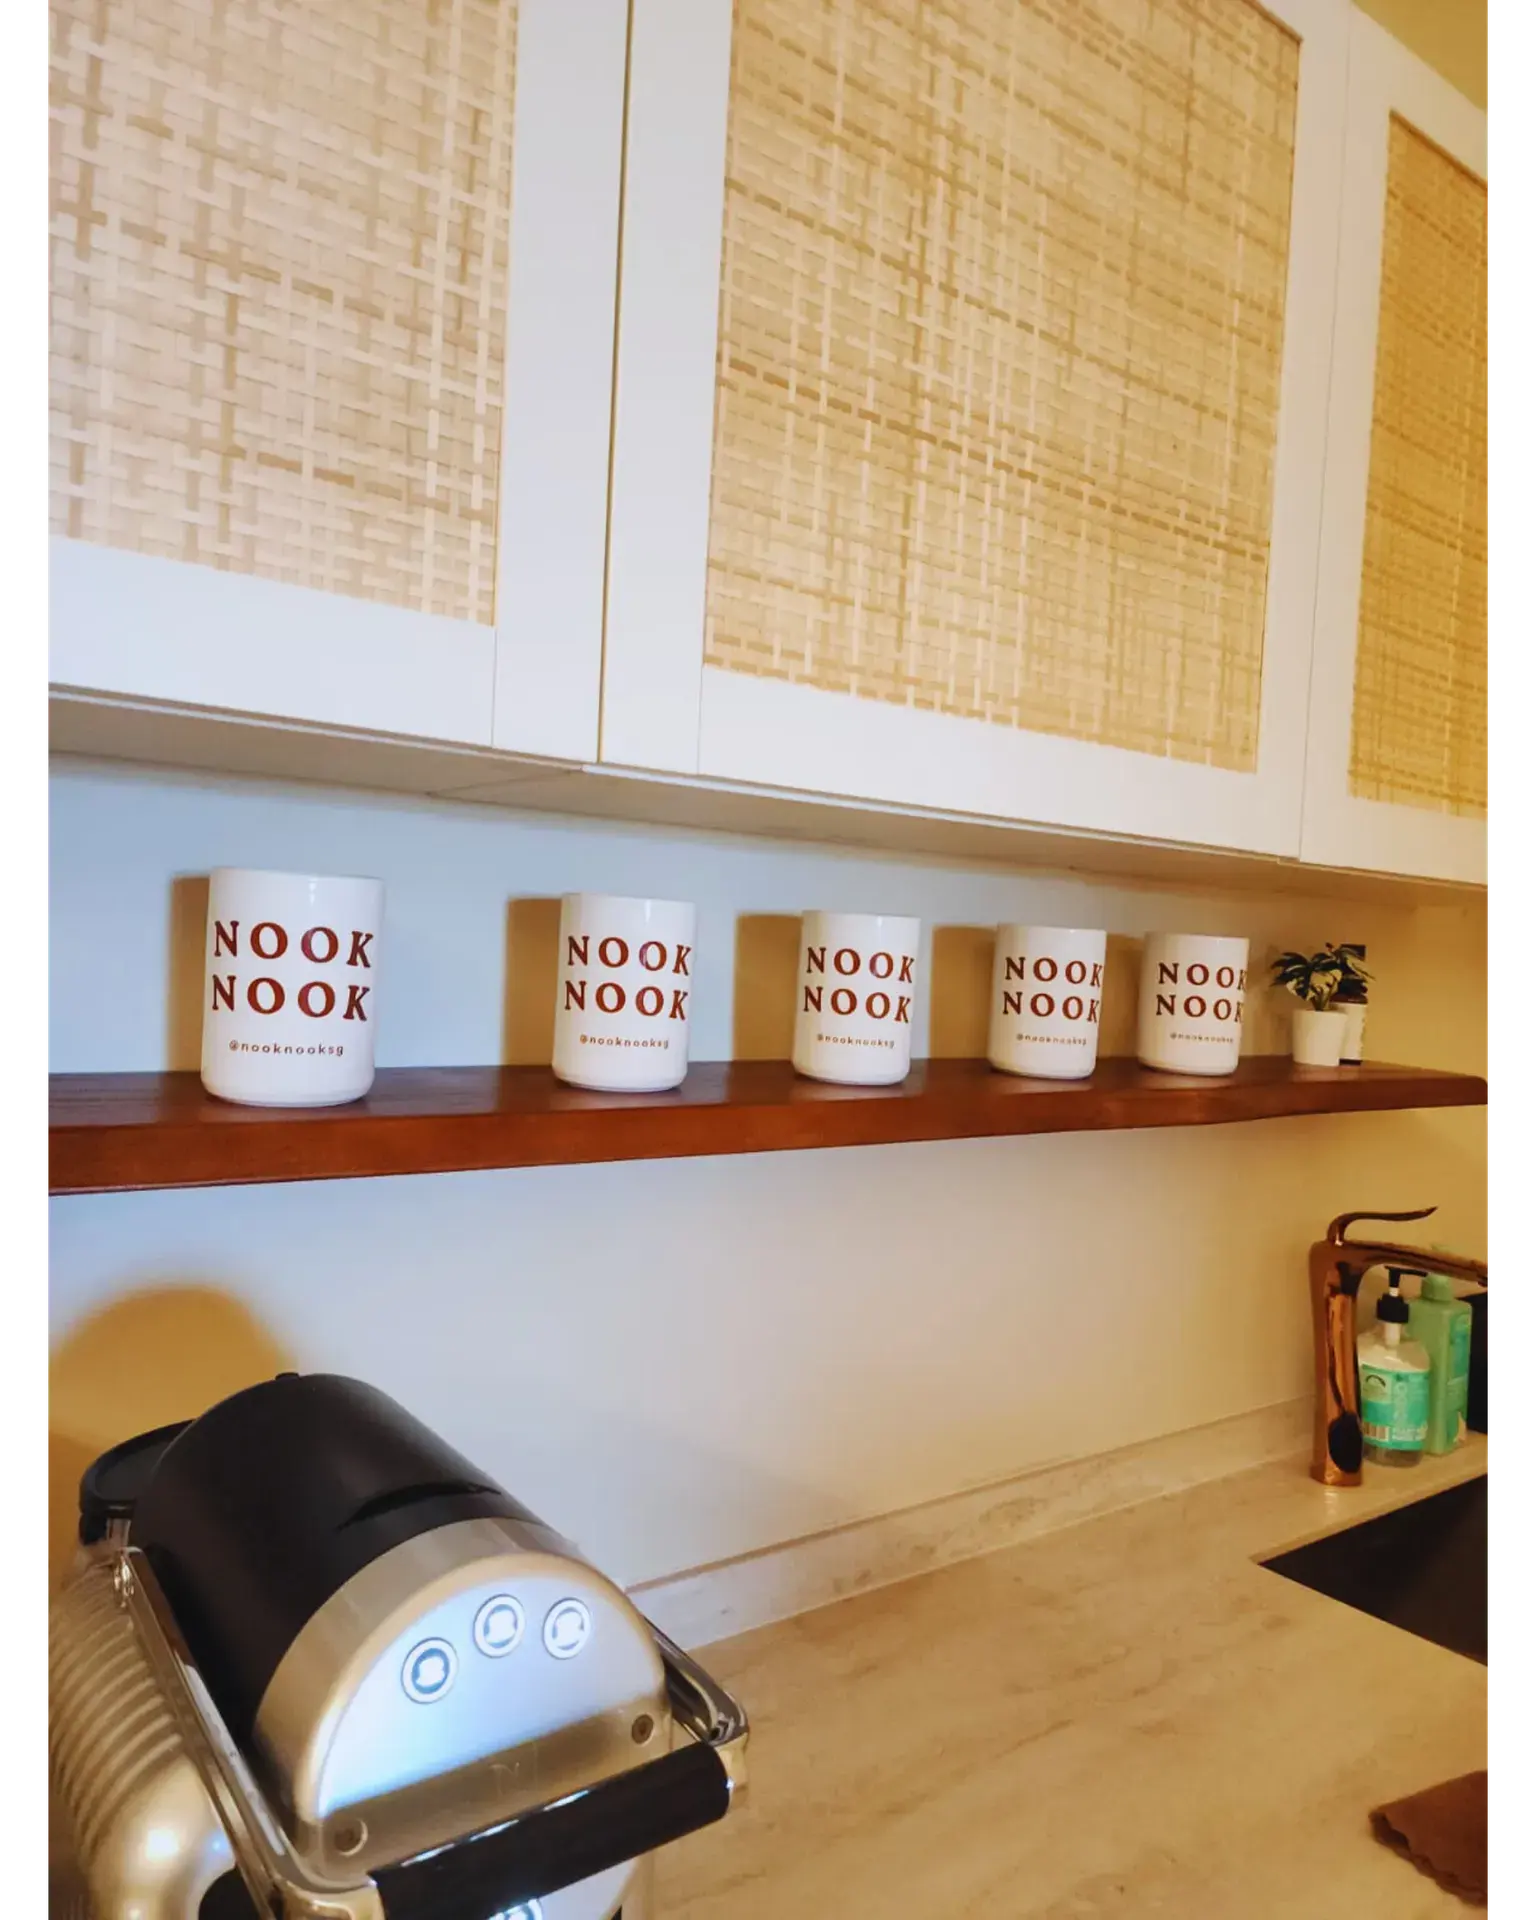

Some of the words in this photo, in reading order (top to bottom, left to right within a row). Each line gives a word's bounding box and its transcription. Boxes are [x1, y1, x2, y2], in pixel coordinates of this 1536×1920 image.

[213, 920, 374, 968] NOOK
[567, 935, 692, 976] NOOK
[806, 947, 915, 983] NOOK
[1004, 956, 1104, 988] NOOK
[211, 974, 370, 1021] NOOK
[564, 980, 689, 1020] NOOK
[803, 986, 911, 1024] NOOK
[1002, 991, 1100, 1024] NOOK
[228, 1039, 345, 1057] @nooknooksg
[579, 1034, 669, 1049] @nooknooksg
